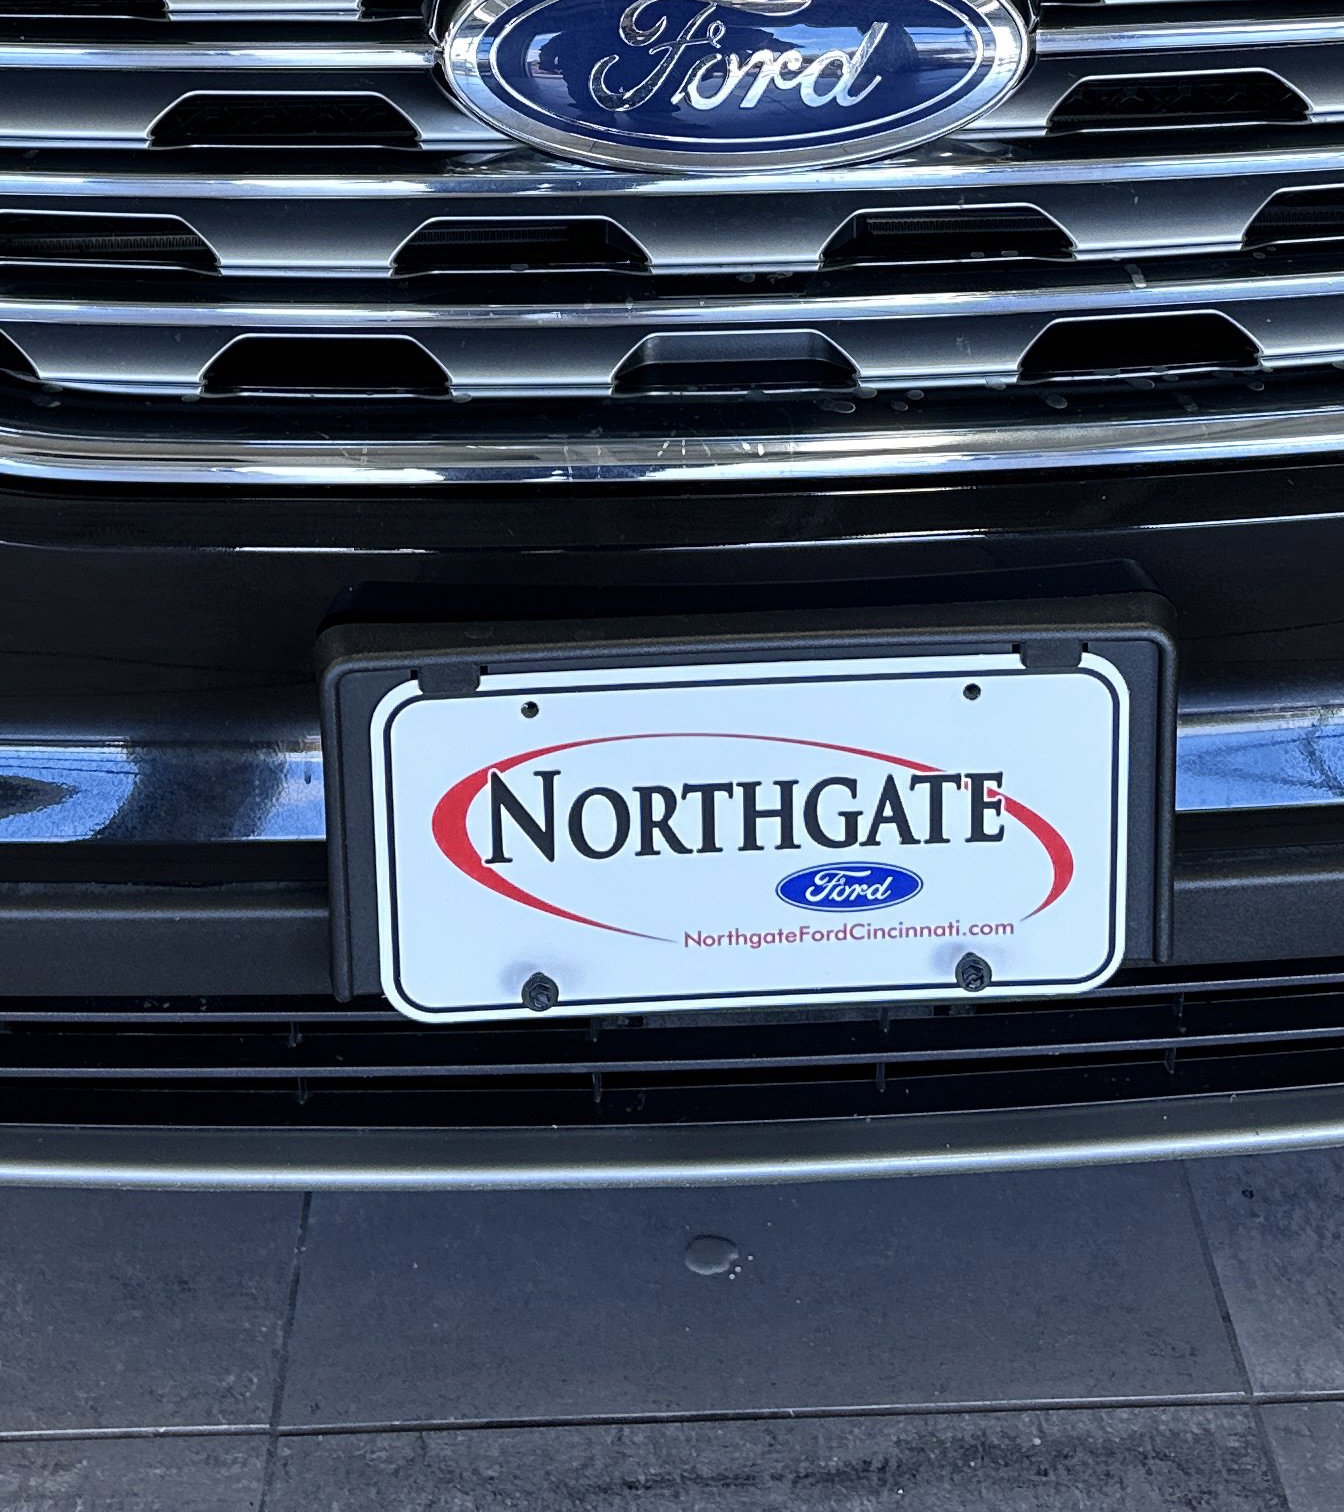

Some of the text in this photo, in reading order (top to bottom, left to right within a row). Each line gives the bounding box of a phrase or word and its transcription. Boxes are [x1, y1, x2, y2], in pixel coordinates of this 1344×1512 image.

[484, 770, 1005, 864] NORTHGATE
[805, 869, 894, 902] Ford
[684, 919, 1014, 949] NorthgateFordCincinnati.com
